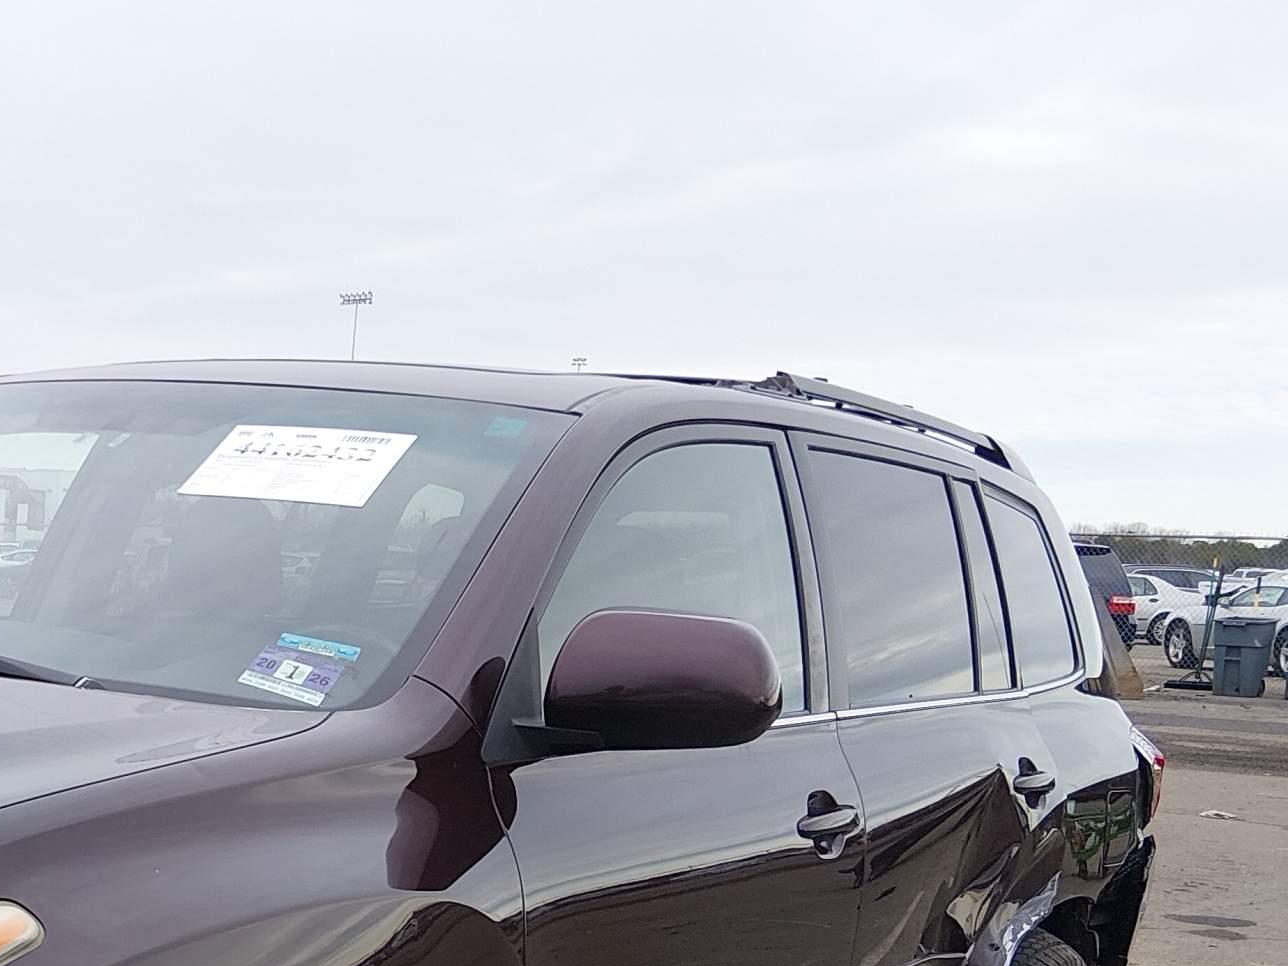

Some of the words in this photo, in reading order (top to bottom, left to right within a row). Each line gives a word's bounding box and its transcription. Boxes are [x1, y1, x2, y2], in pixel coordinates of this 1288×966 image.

[256, 657, 277, 670] 20
[285, 665, 300, 680] 1
[309, 673, 331, 686] 26
